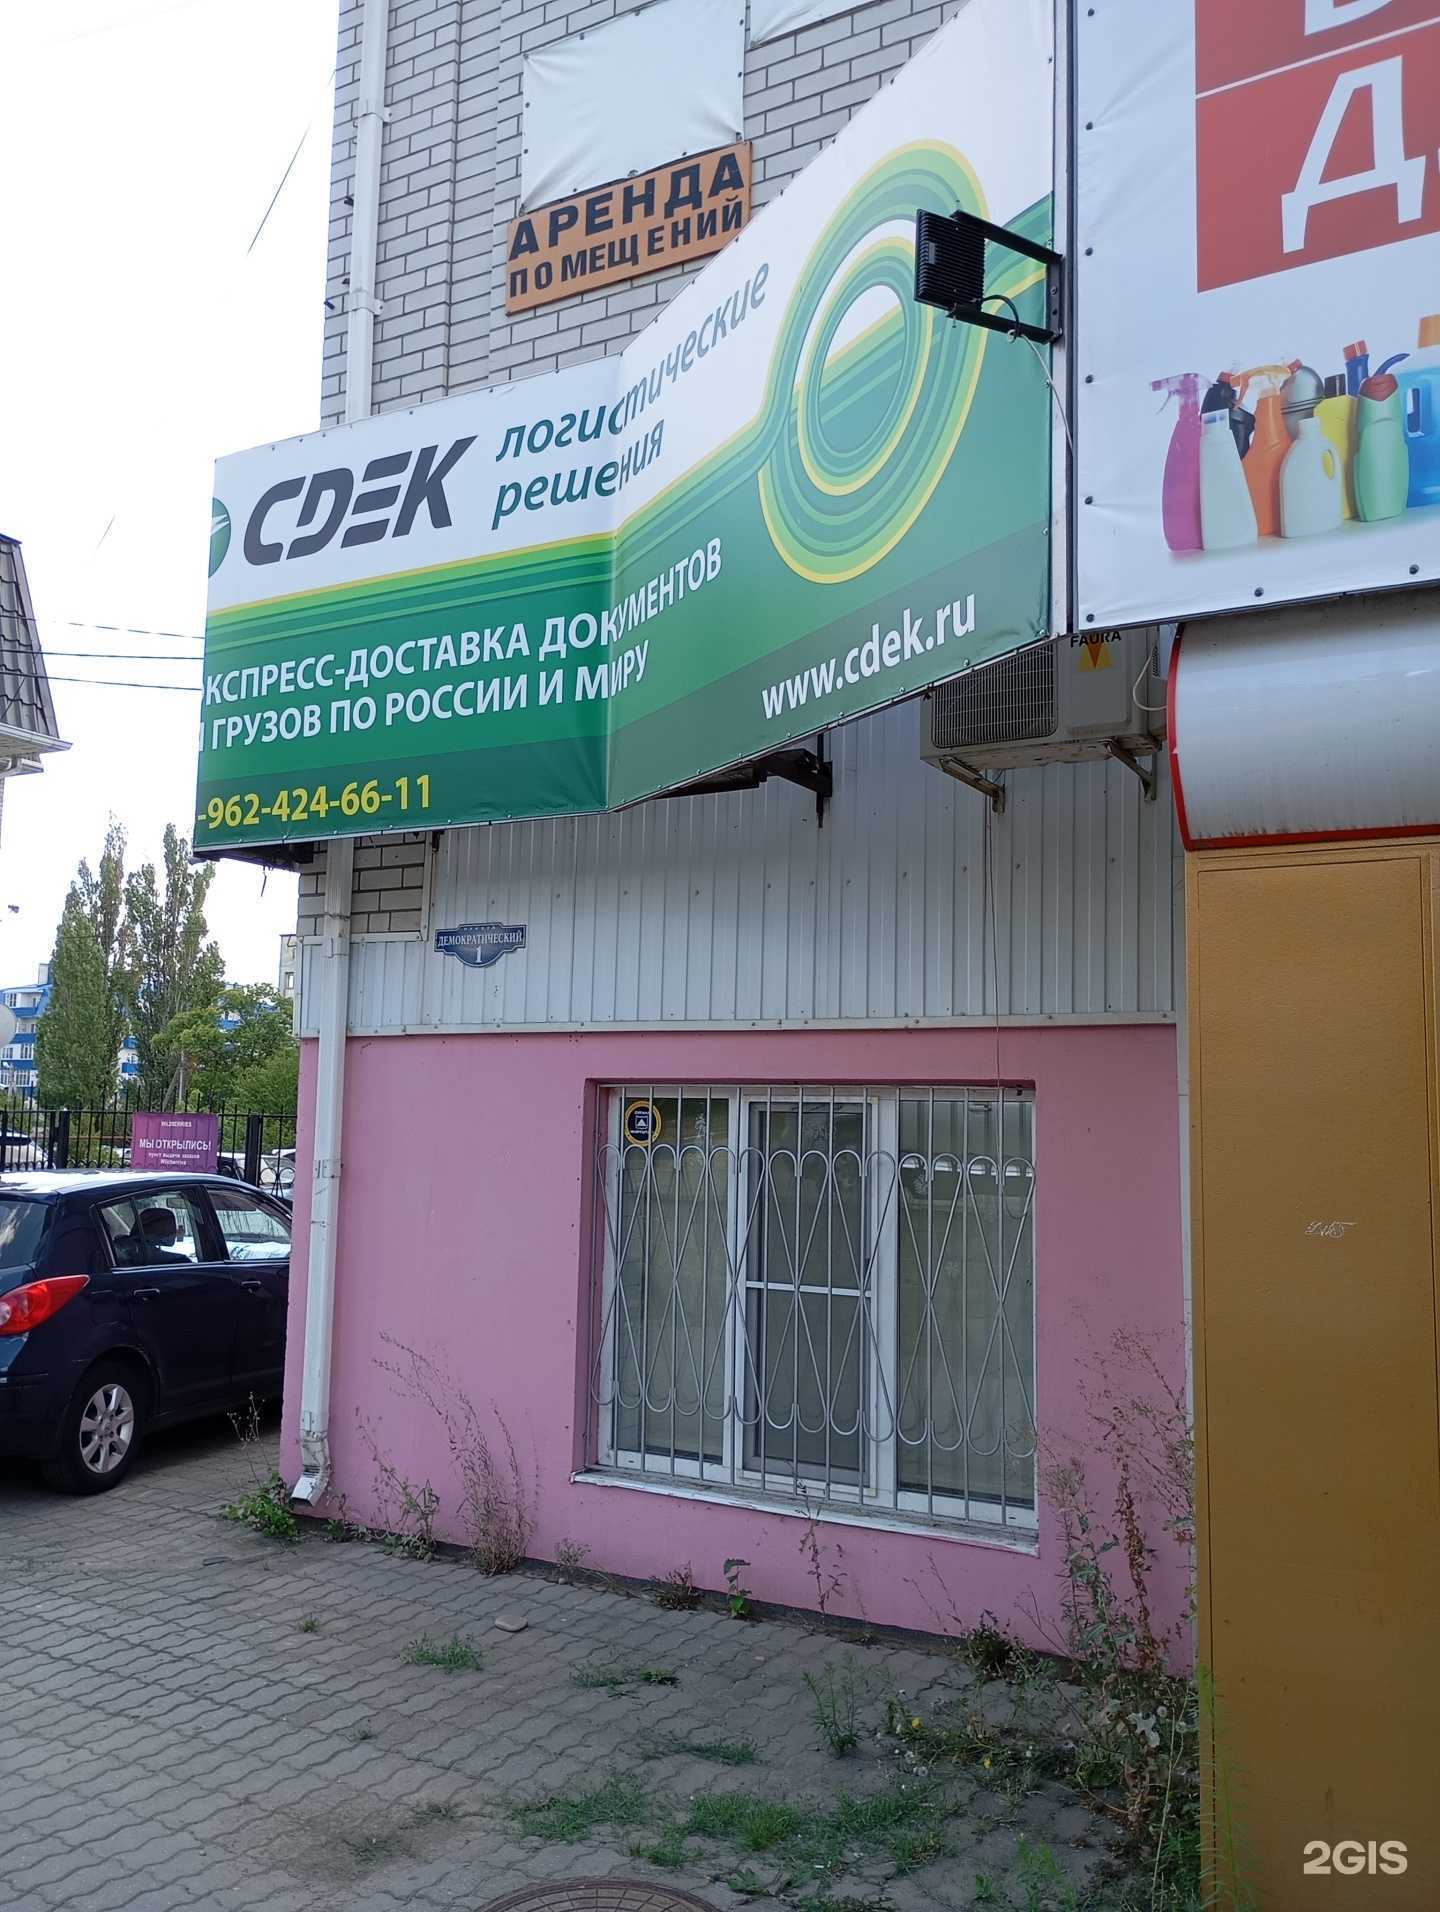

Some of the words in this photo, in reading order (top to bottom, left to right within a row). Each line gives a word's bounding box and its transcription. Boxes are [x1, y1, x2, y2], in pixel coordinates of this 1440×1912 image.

[508, 153, 745, 261] АРЕНДА
[1281, 55, 1440, 254] Д
[509, 194, 743, 298] ПОМЕЩЕНИЙ
[495, 263, 769, 462] логистические
[243, 435, 478, 566] CDEK
[491, 419, 665, 531] решения
[538, 537, 722, 662] ДОКУМЕНТОВ
[1070, 631, 1122, 648] FAURA
[212, 704, 322, 750] ГРУЗОВ
[330, 697, 377, 733] ПО
[385, 674, 528, 726] РОССИИ
[538, 668, 564, 706] И
[574, 639, 649, 701] МИРУ
[762, 594, 976, 720] www.cdek.ru
[198, 774, 432, 829] -962-424-66-11
[437, 929, 522, 947] ДЕМОКРАТИЧЕСКИЙ
[140, 1138, 154, 1149] МЫ
[155, 1139, 211, 1151] ОТКРЫЛИСЬ!
